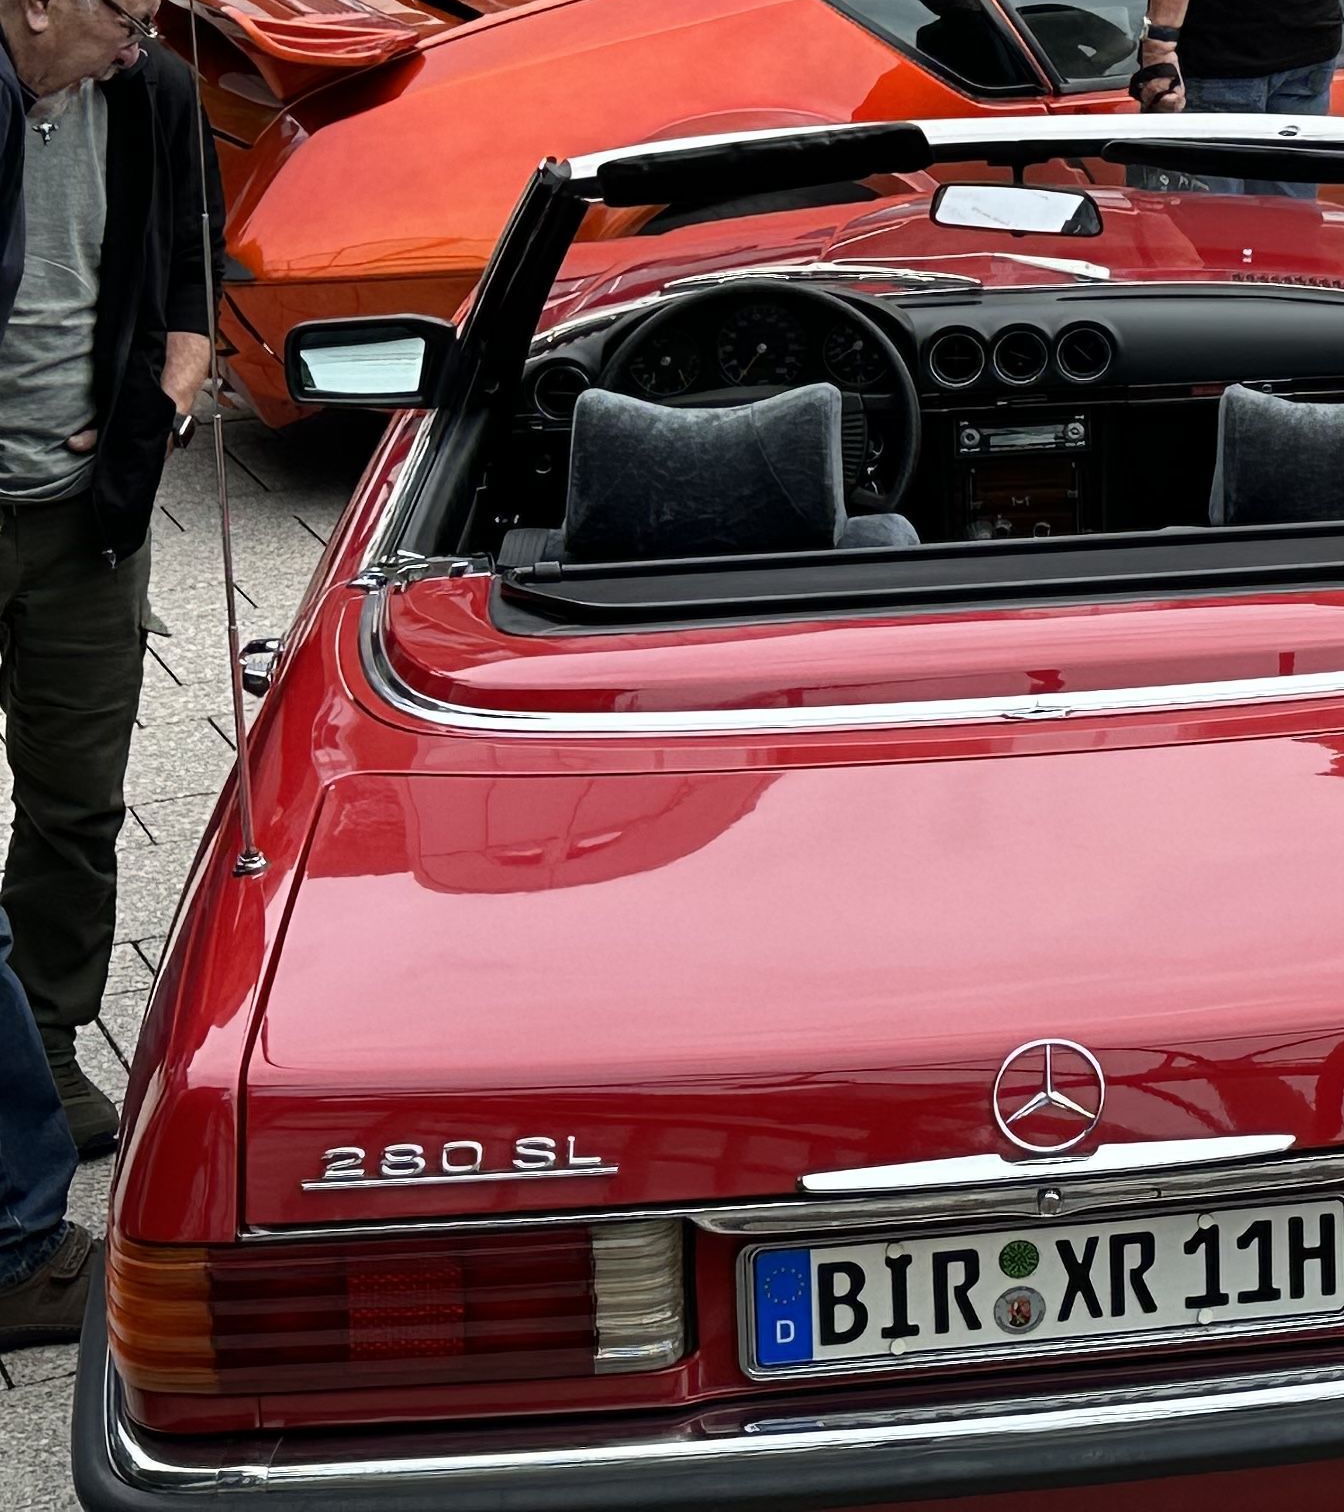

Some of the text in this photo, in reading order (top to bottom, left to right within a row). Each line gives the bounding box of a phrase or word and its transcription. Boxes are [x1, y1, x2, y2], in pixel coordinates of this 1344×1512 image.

[320, 1135, 603, 1180] 280 SL
[775, 1213, 1337, 1347] D BIR XR 11H
